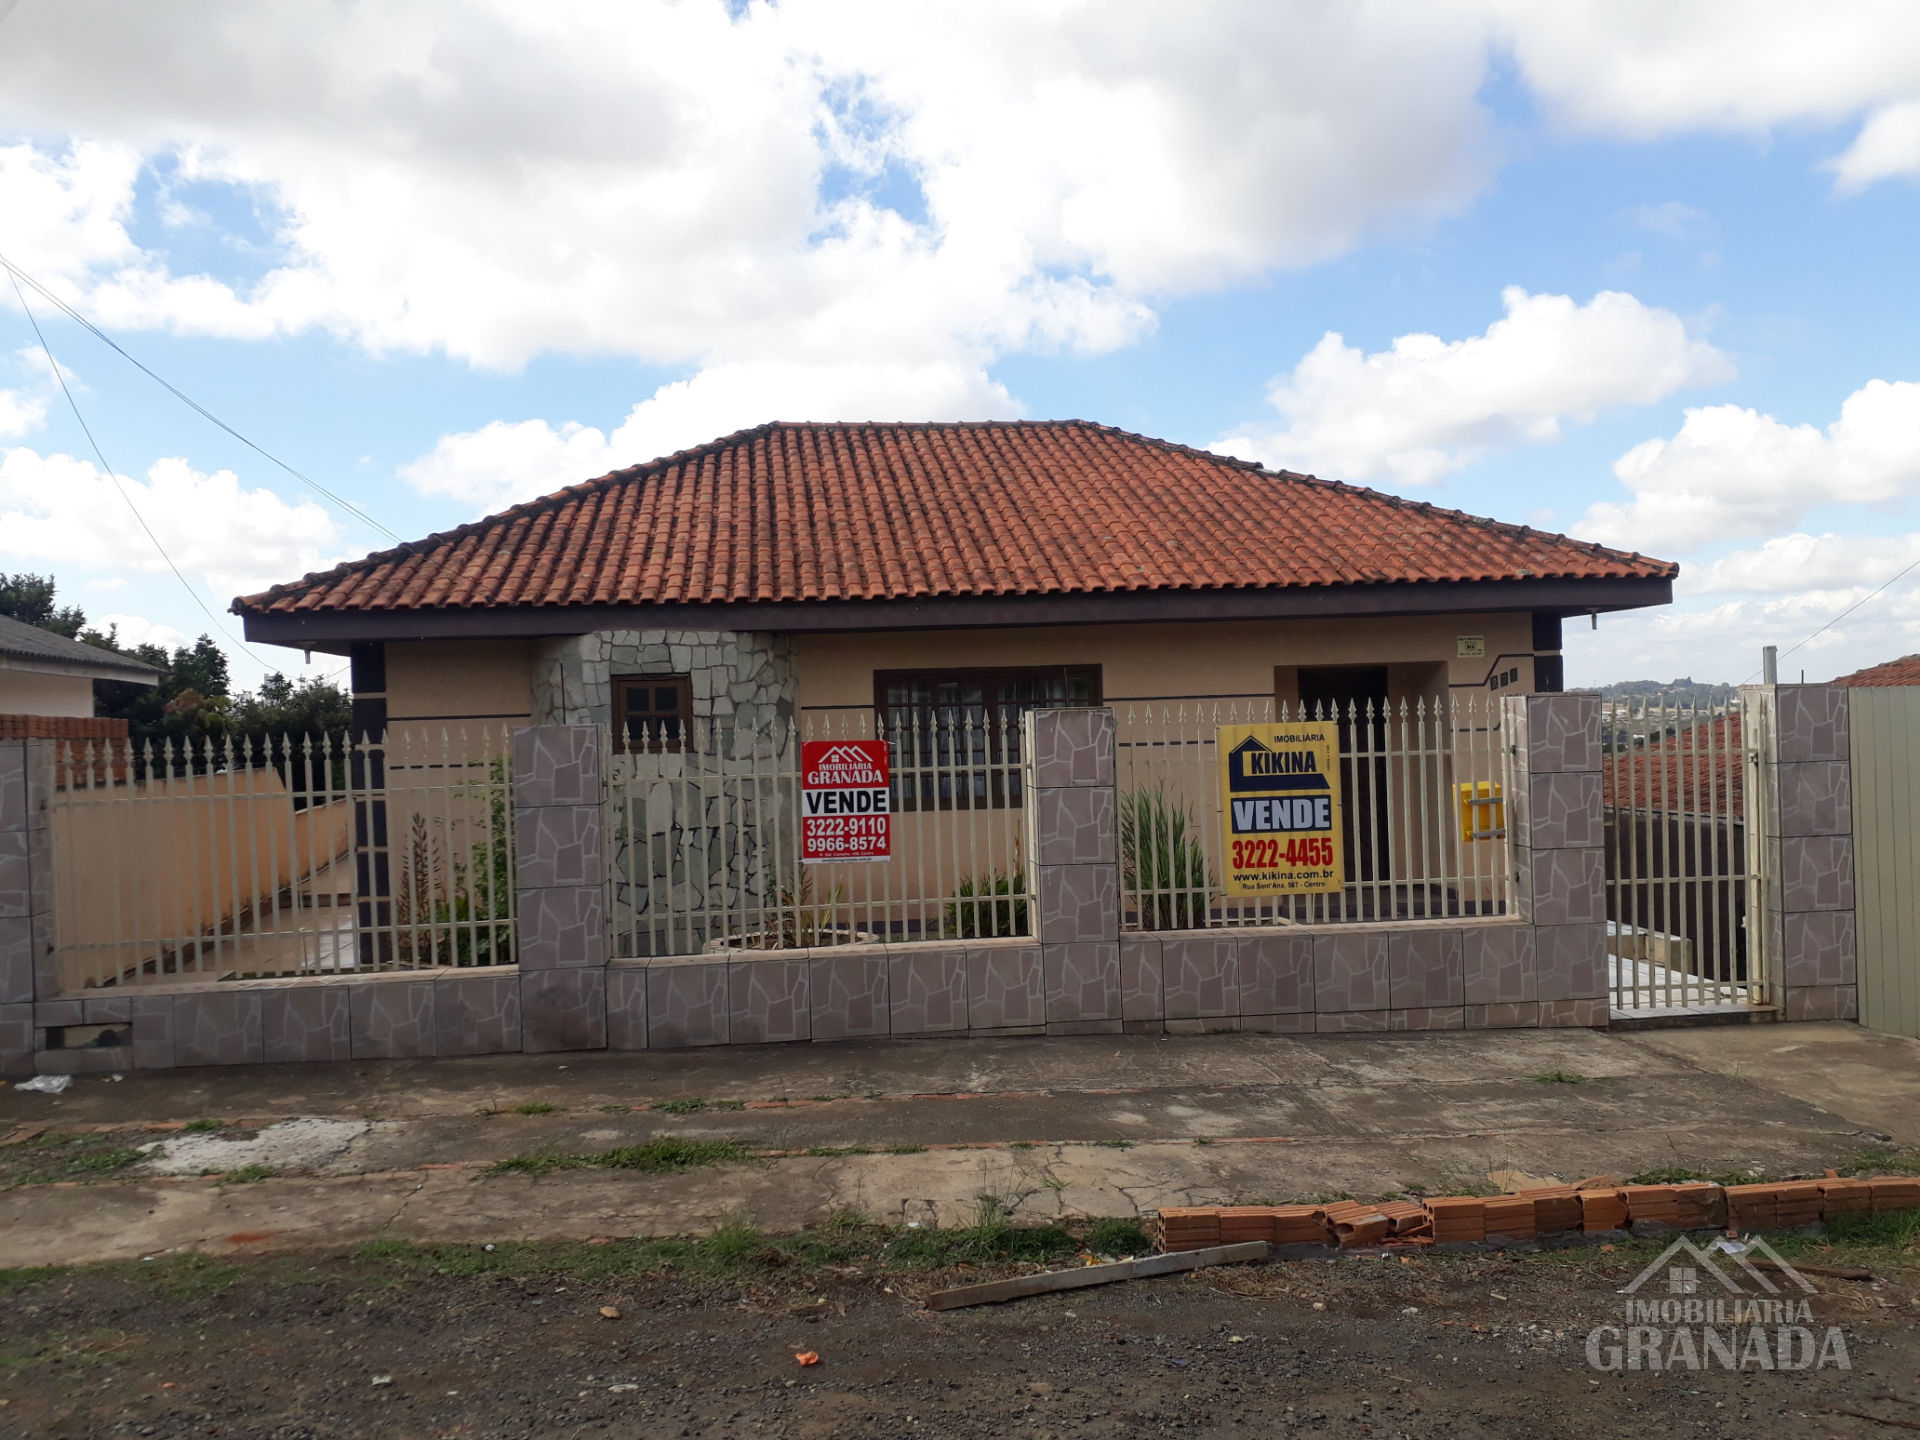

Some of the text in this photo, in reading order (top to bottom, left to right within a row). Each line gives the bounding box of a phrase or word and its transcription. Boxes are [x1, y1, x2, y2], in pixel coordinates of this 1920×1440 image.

[1274, 733, 1325, 743] IMOBILIÁRIA
[1251, 751, 1317, 775] KIKINA
[807, 769, 884, 785] GRANADA
[805, 790, 887, 814] VENDE
[1232, 798, 1330, 831] VENDE
[806, 817, 887, 837] 3222-9110
[807, 836, 887, 852] 9966-8574
[1232, 837, 1334, 870] 3222-4455
[1233, 869, 1334, 882] www.kikina.com.br
